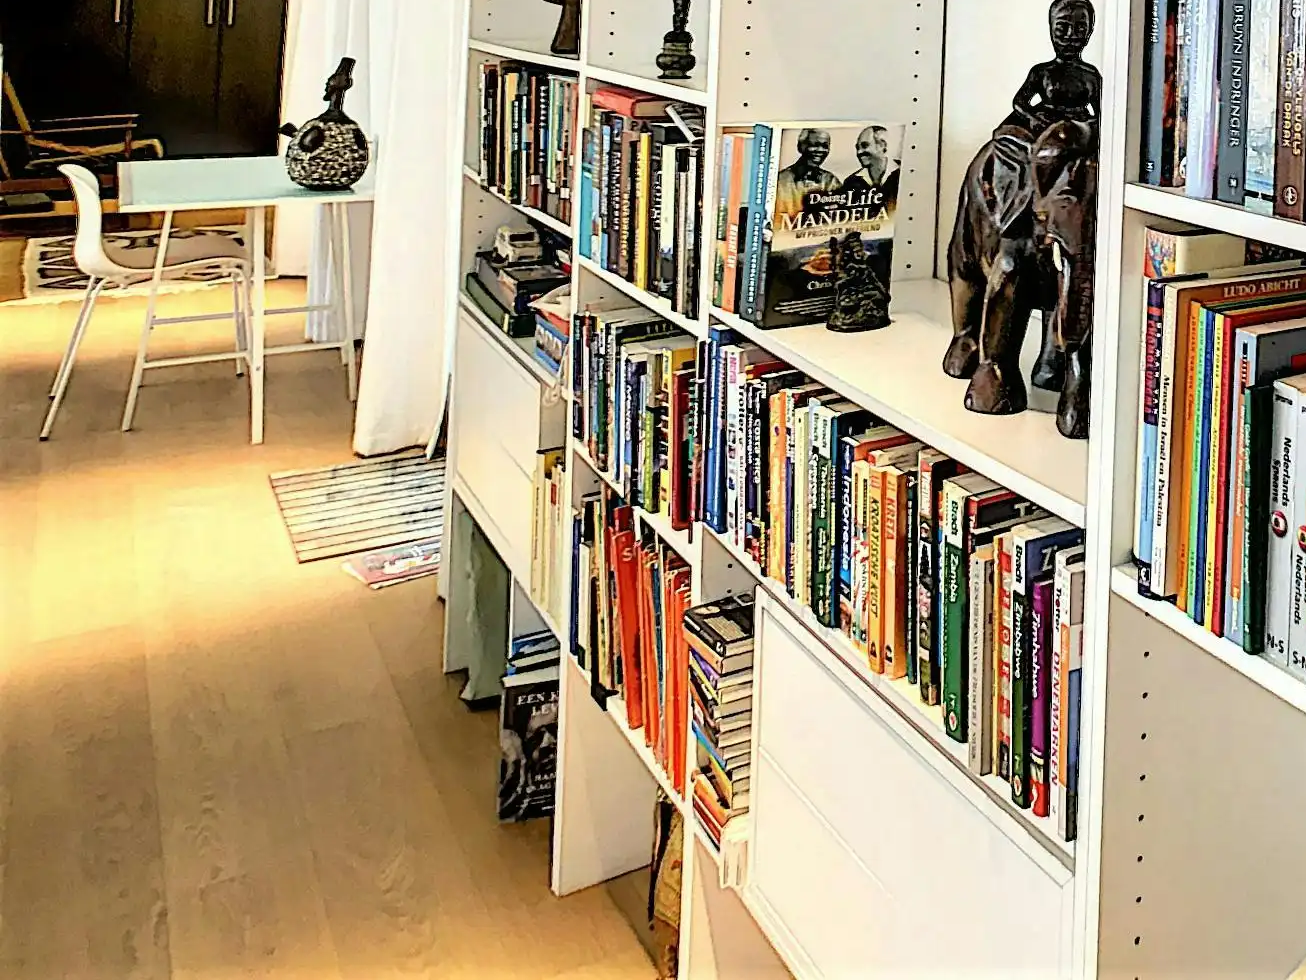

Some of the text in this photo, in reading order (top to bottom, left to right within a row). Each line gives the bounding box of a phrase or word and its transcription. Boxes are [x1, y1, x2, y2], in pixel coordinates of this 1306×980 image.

[1231, 4, 1245, 55] BRUYN
[1229, 59, 1244, 147] INDRINGER
[783, 208, 889, 231] MANDELA
[809, 188, 883, 206] Doing Life
[1281, 436, 1292, 508] Nederlands
[840, 474, 852, 570] Indonesia
[884, 496, 896, 540] KRETA
[869, 496, 881, 619] KROATISCHE KUST
[1012, 601, 1024, 679] Zimbabwe
[1053, 586, 1063, 633] Trotter
[1029, 609, 1042, 699] Zimbabwe
[1049, 650, 1062, 787] DENEMARKEN
